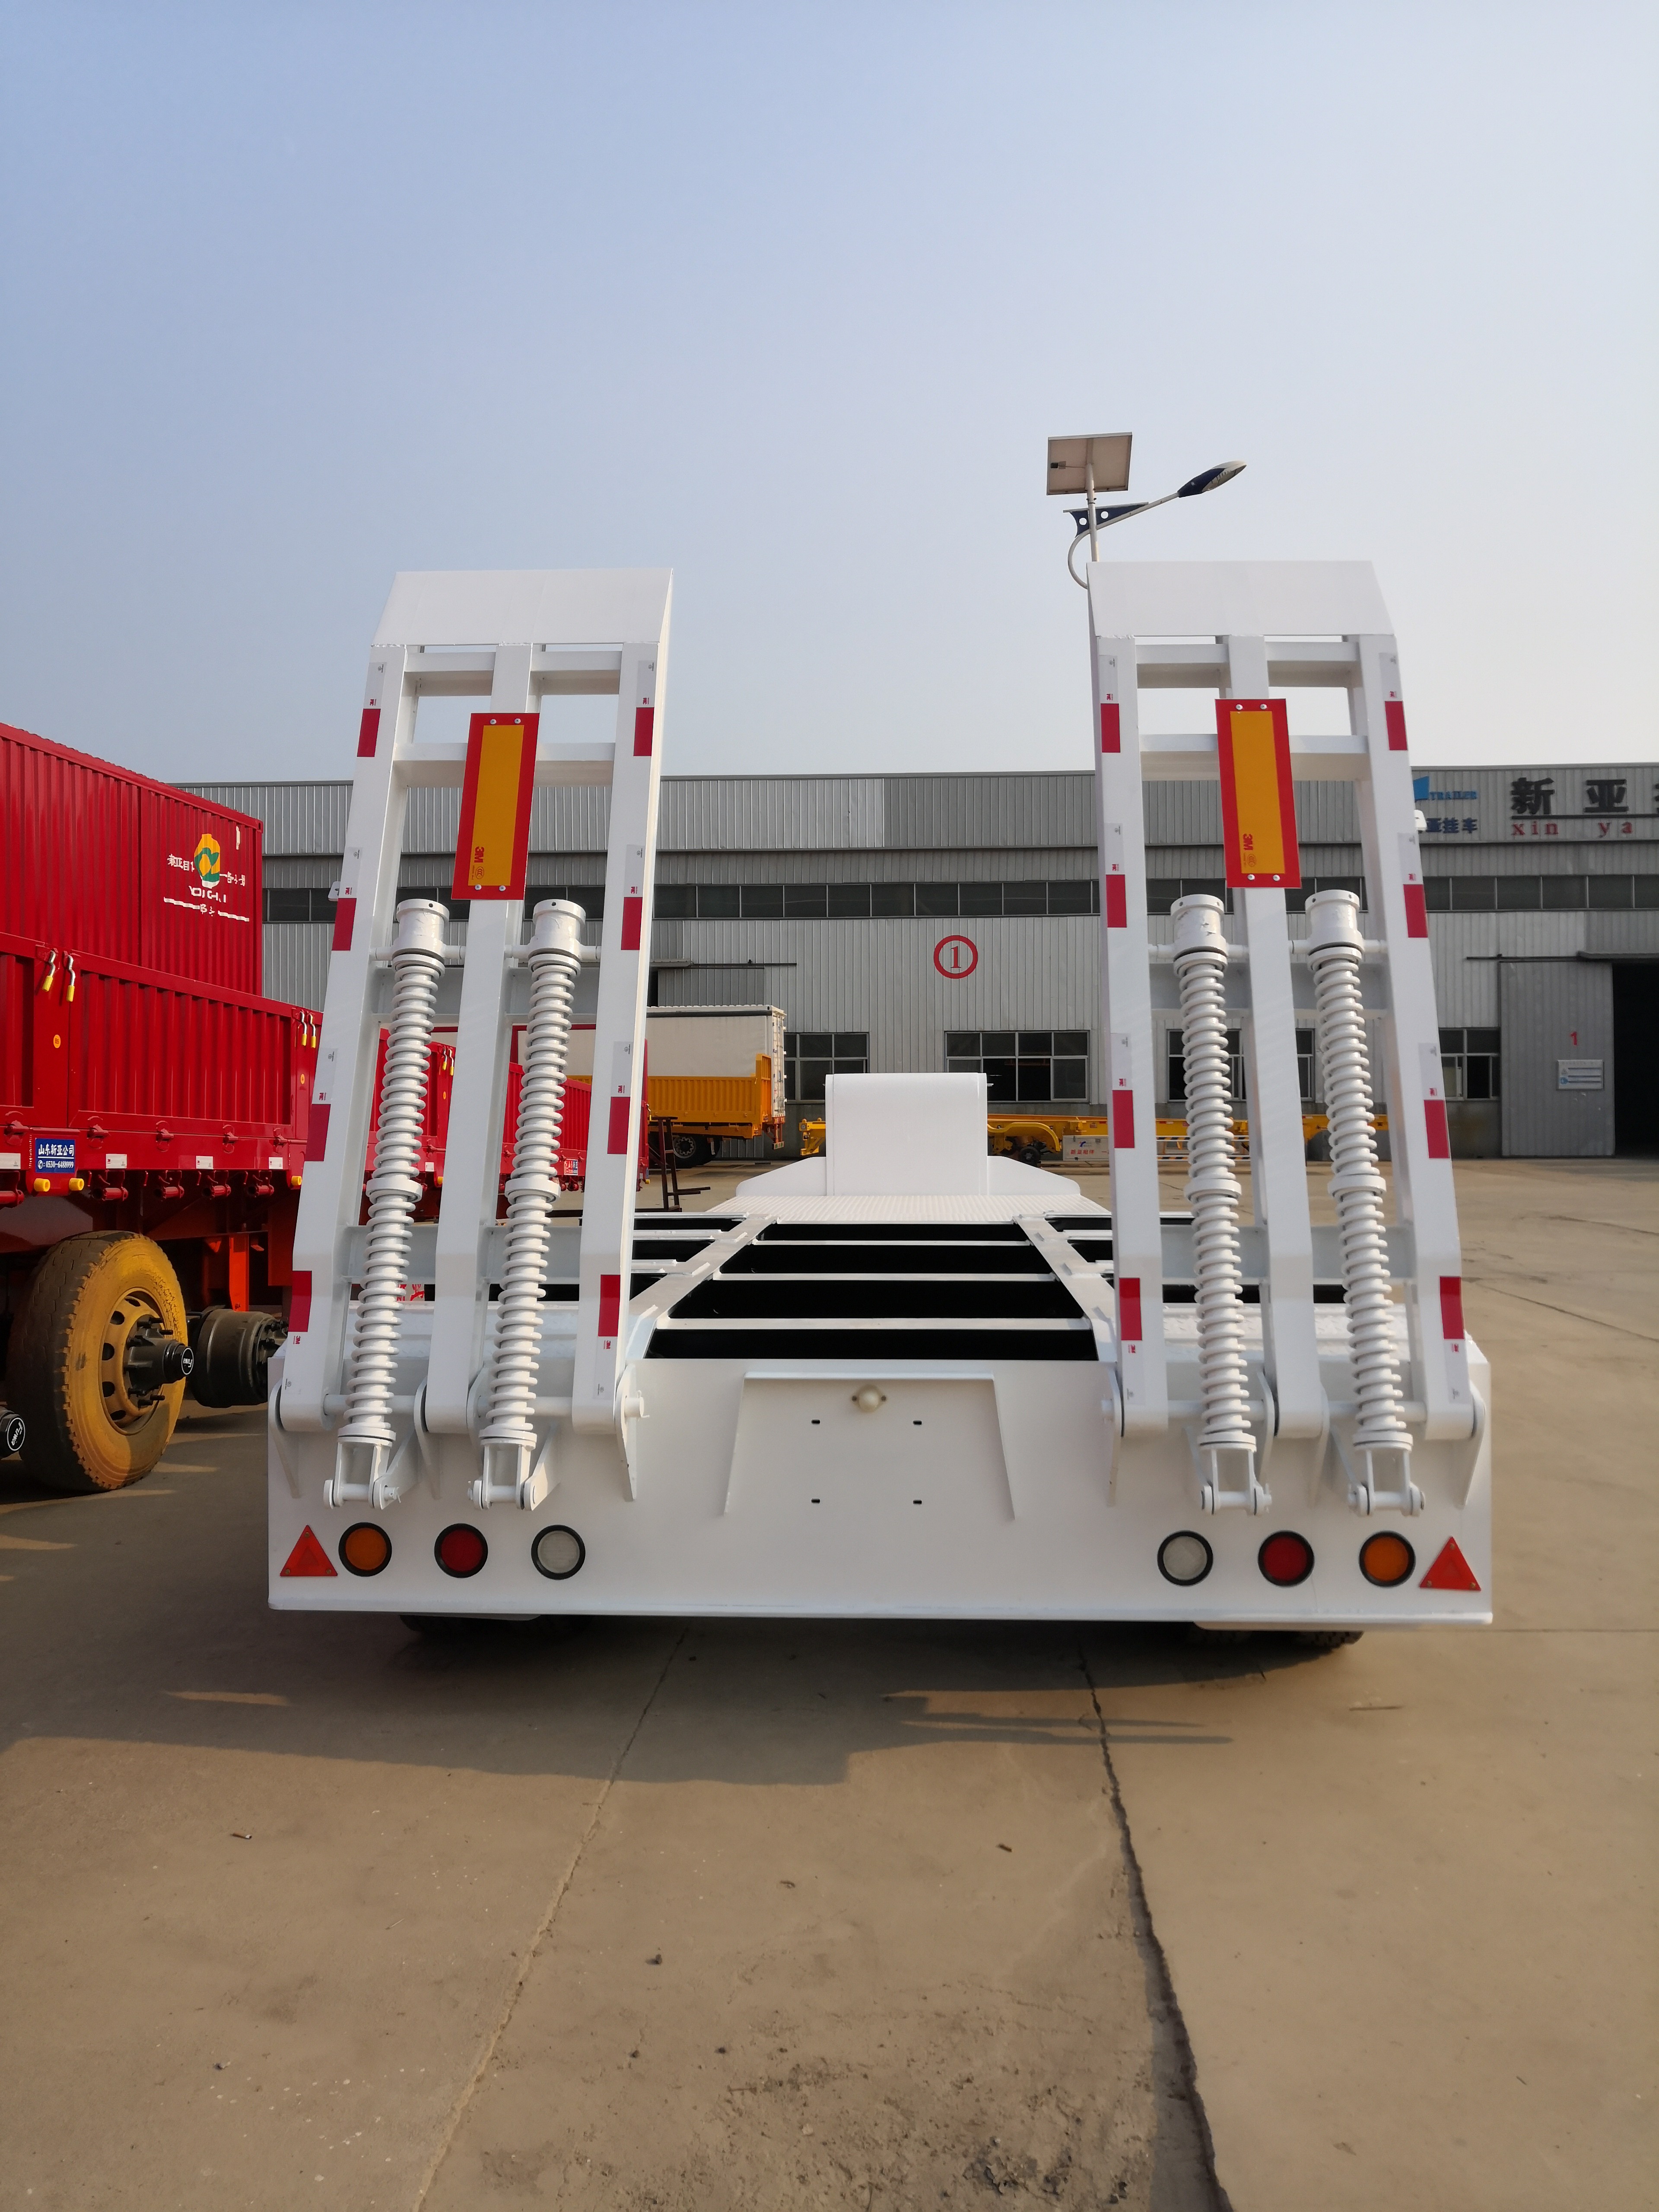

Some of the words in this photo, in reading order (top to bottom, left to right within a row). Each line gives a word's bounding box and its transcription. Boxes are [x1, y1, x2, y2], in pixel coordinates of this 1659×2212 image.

[1511, 777, 1659, 814] 新亚
[1419, 817, 1478, 833] 亚挂车
[1512, 821, 1558, 835] xin
[1599, 821, 1633, 838] ya
[1243, 833, 1253, 850] 3M
[474, 846, 485, 863] 3M
[1570, 1031, 1577, 1046] 1
[319, 1092, 324, 1100] 3M
[38, 1144, 74, 1156] 山东新亚公司
[296, 1336, 301, 1344] 3M
[11, 1421, 23, 1446] Fuwa
